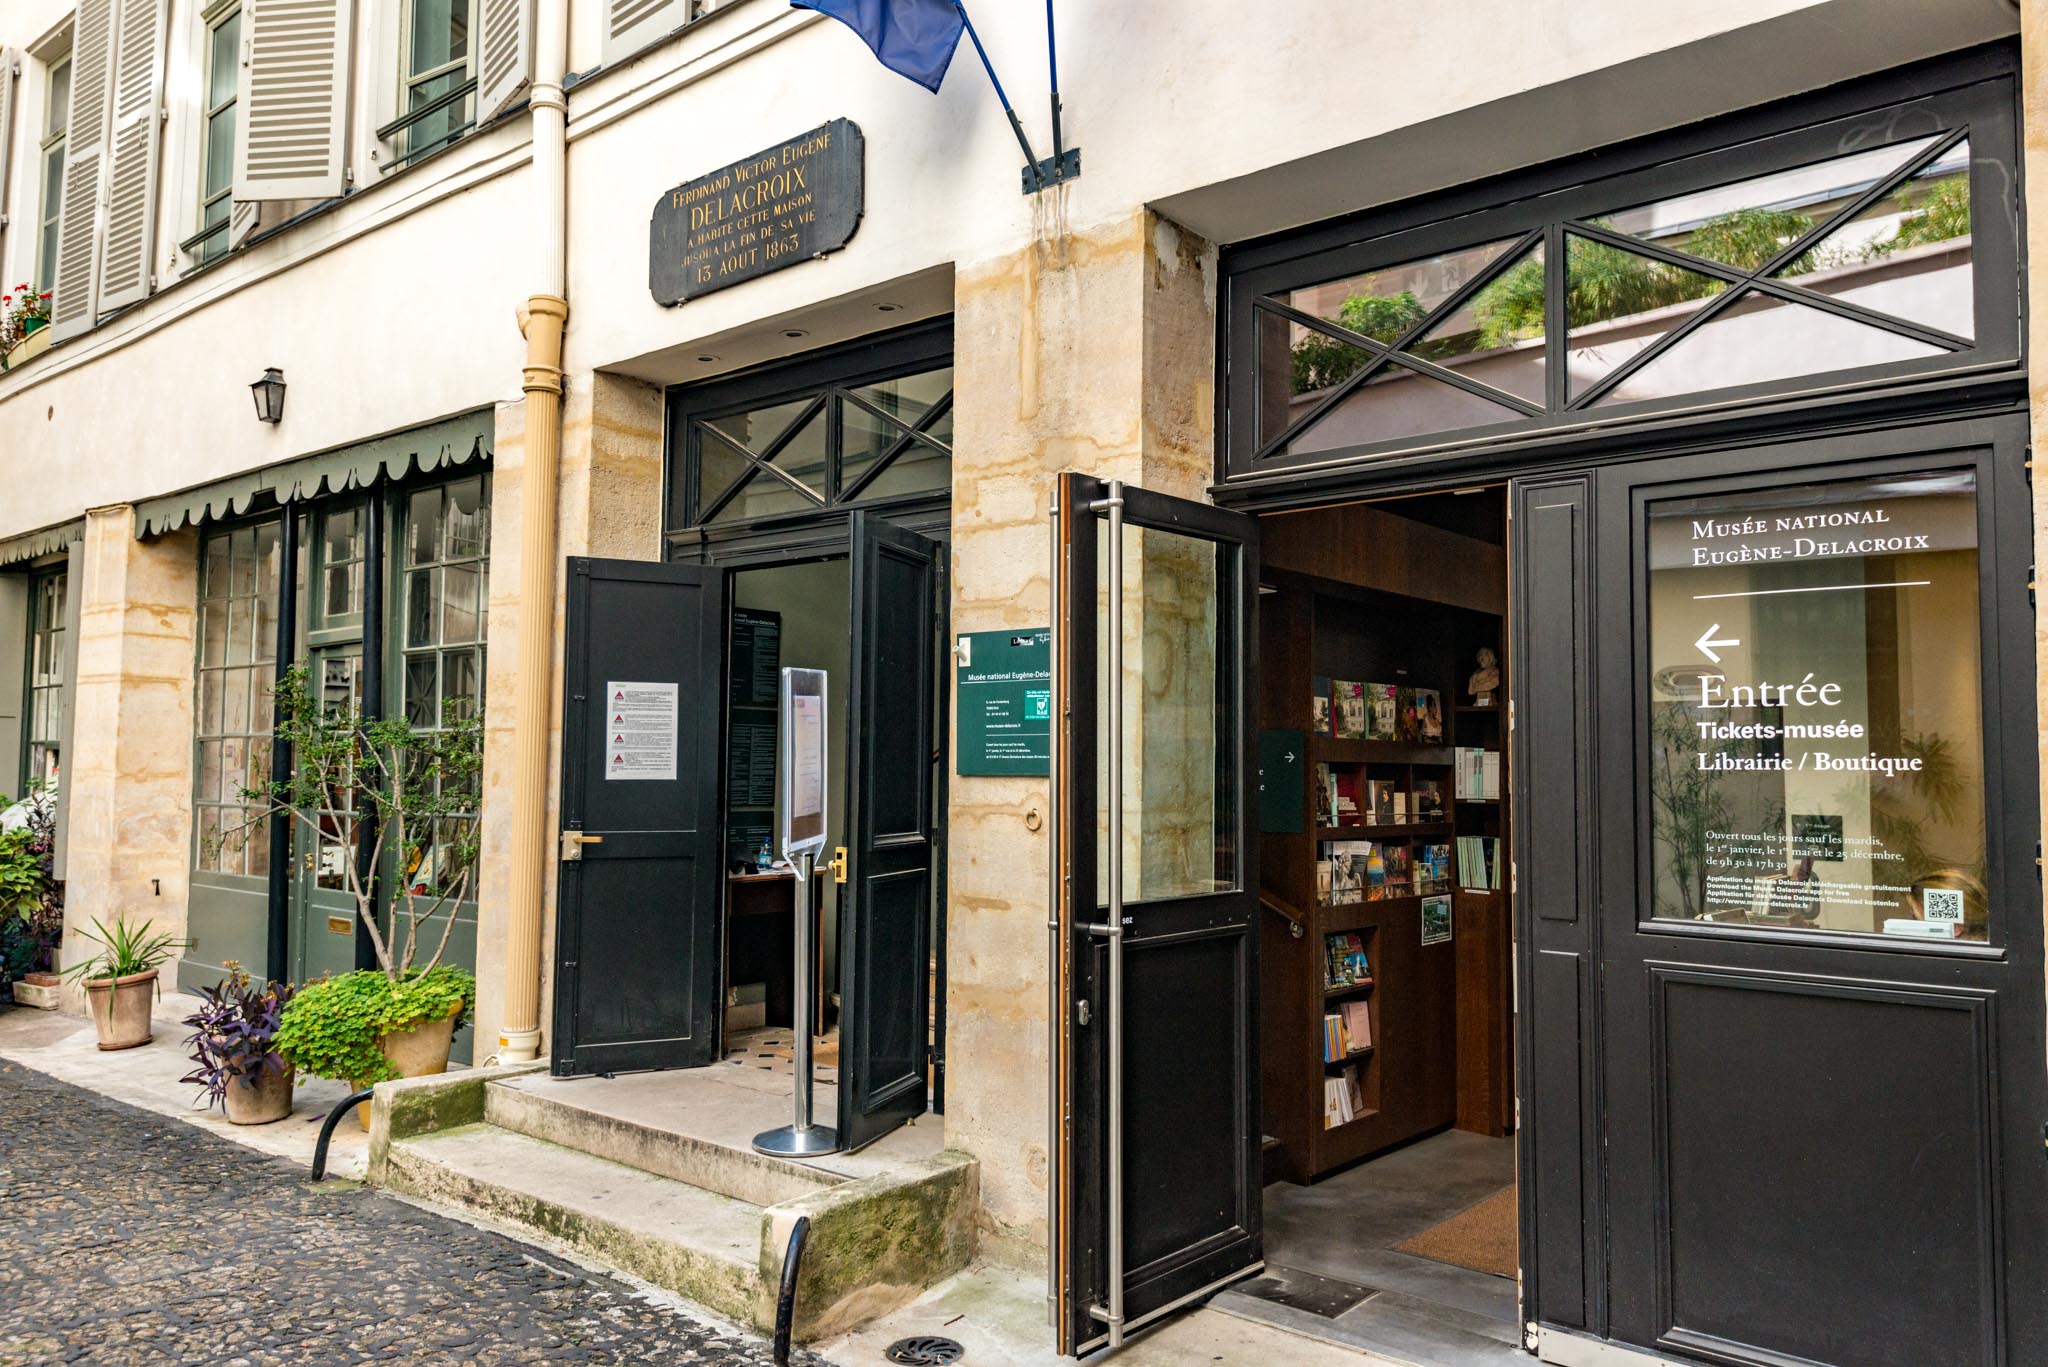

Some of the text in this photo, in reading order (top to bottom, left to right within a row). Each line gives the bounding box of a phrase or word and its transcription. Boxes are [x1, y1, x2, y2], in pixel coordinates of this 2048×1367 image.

[673, 175, 731, 209] FERDINAND
[735, 156, 776, 183] VICTOR
[691, 164, 806, 231] DELACROIX
[687, 192, 812, 249] A HABITE CETTE MAISON
[724, 239, 736, 253] LA
[740, 231, 756, 247] FIN
[760, 224, 774, 240] DE
[780, 218, 793, 231] SA
[798, 208, 816, 225] VIE
[698, 264, 712, 284] 13
[765, 233, 799, 261] 1863
[1775, 508, 1890, 532] NATIONAL
[967, 671, 986, 682] Musée
[987, 671, 1011, 680] national
[1696, 672, 1842, 709] Entrée
[1697, 719, 1865, 740] Tickets-musée
[1697, 751, 1794, 771] Librairie
[1813, 751, 1923, 777] Boutique
[1705, 830, 1884, 847] Ouvert tous les jours sauf les mardis,
[1705, 843, 1714, 852] le
[1729, 844, 1765, 855] janvier,
[1767, 845, 1776, 855] le
[1792, 847, 1810, 856] mai
[1812, 849, 1823, 857] et
[1824, 848, 1834, 858] le
[1836, 851, 1848, 860] 25
[1850, 849, 1905, 862] décembre,
[1705, 856, 1718, 865] de
[1706, 875, 1743, 884] Application
